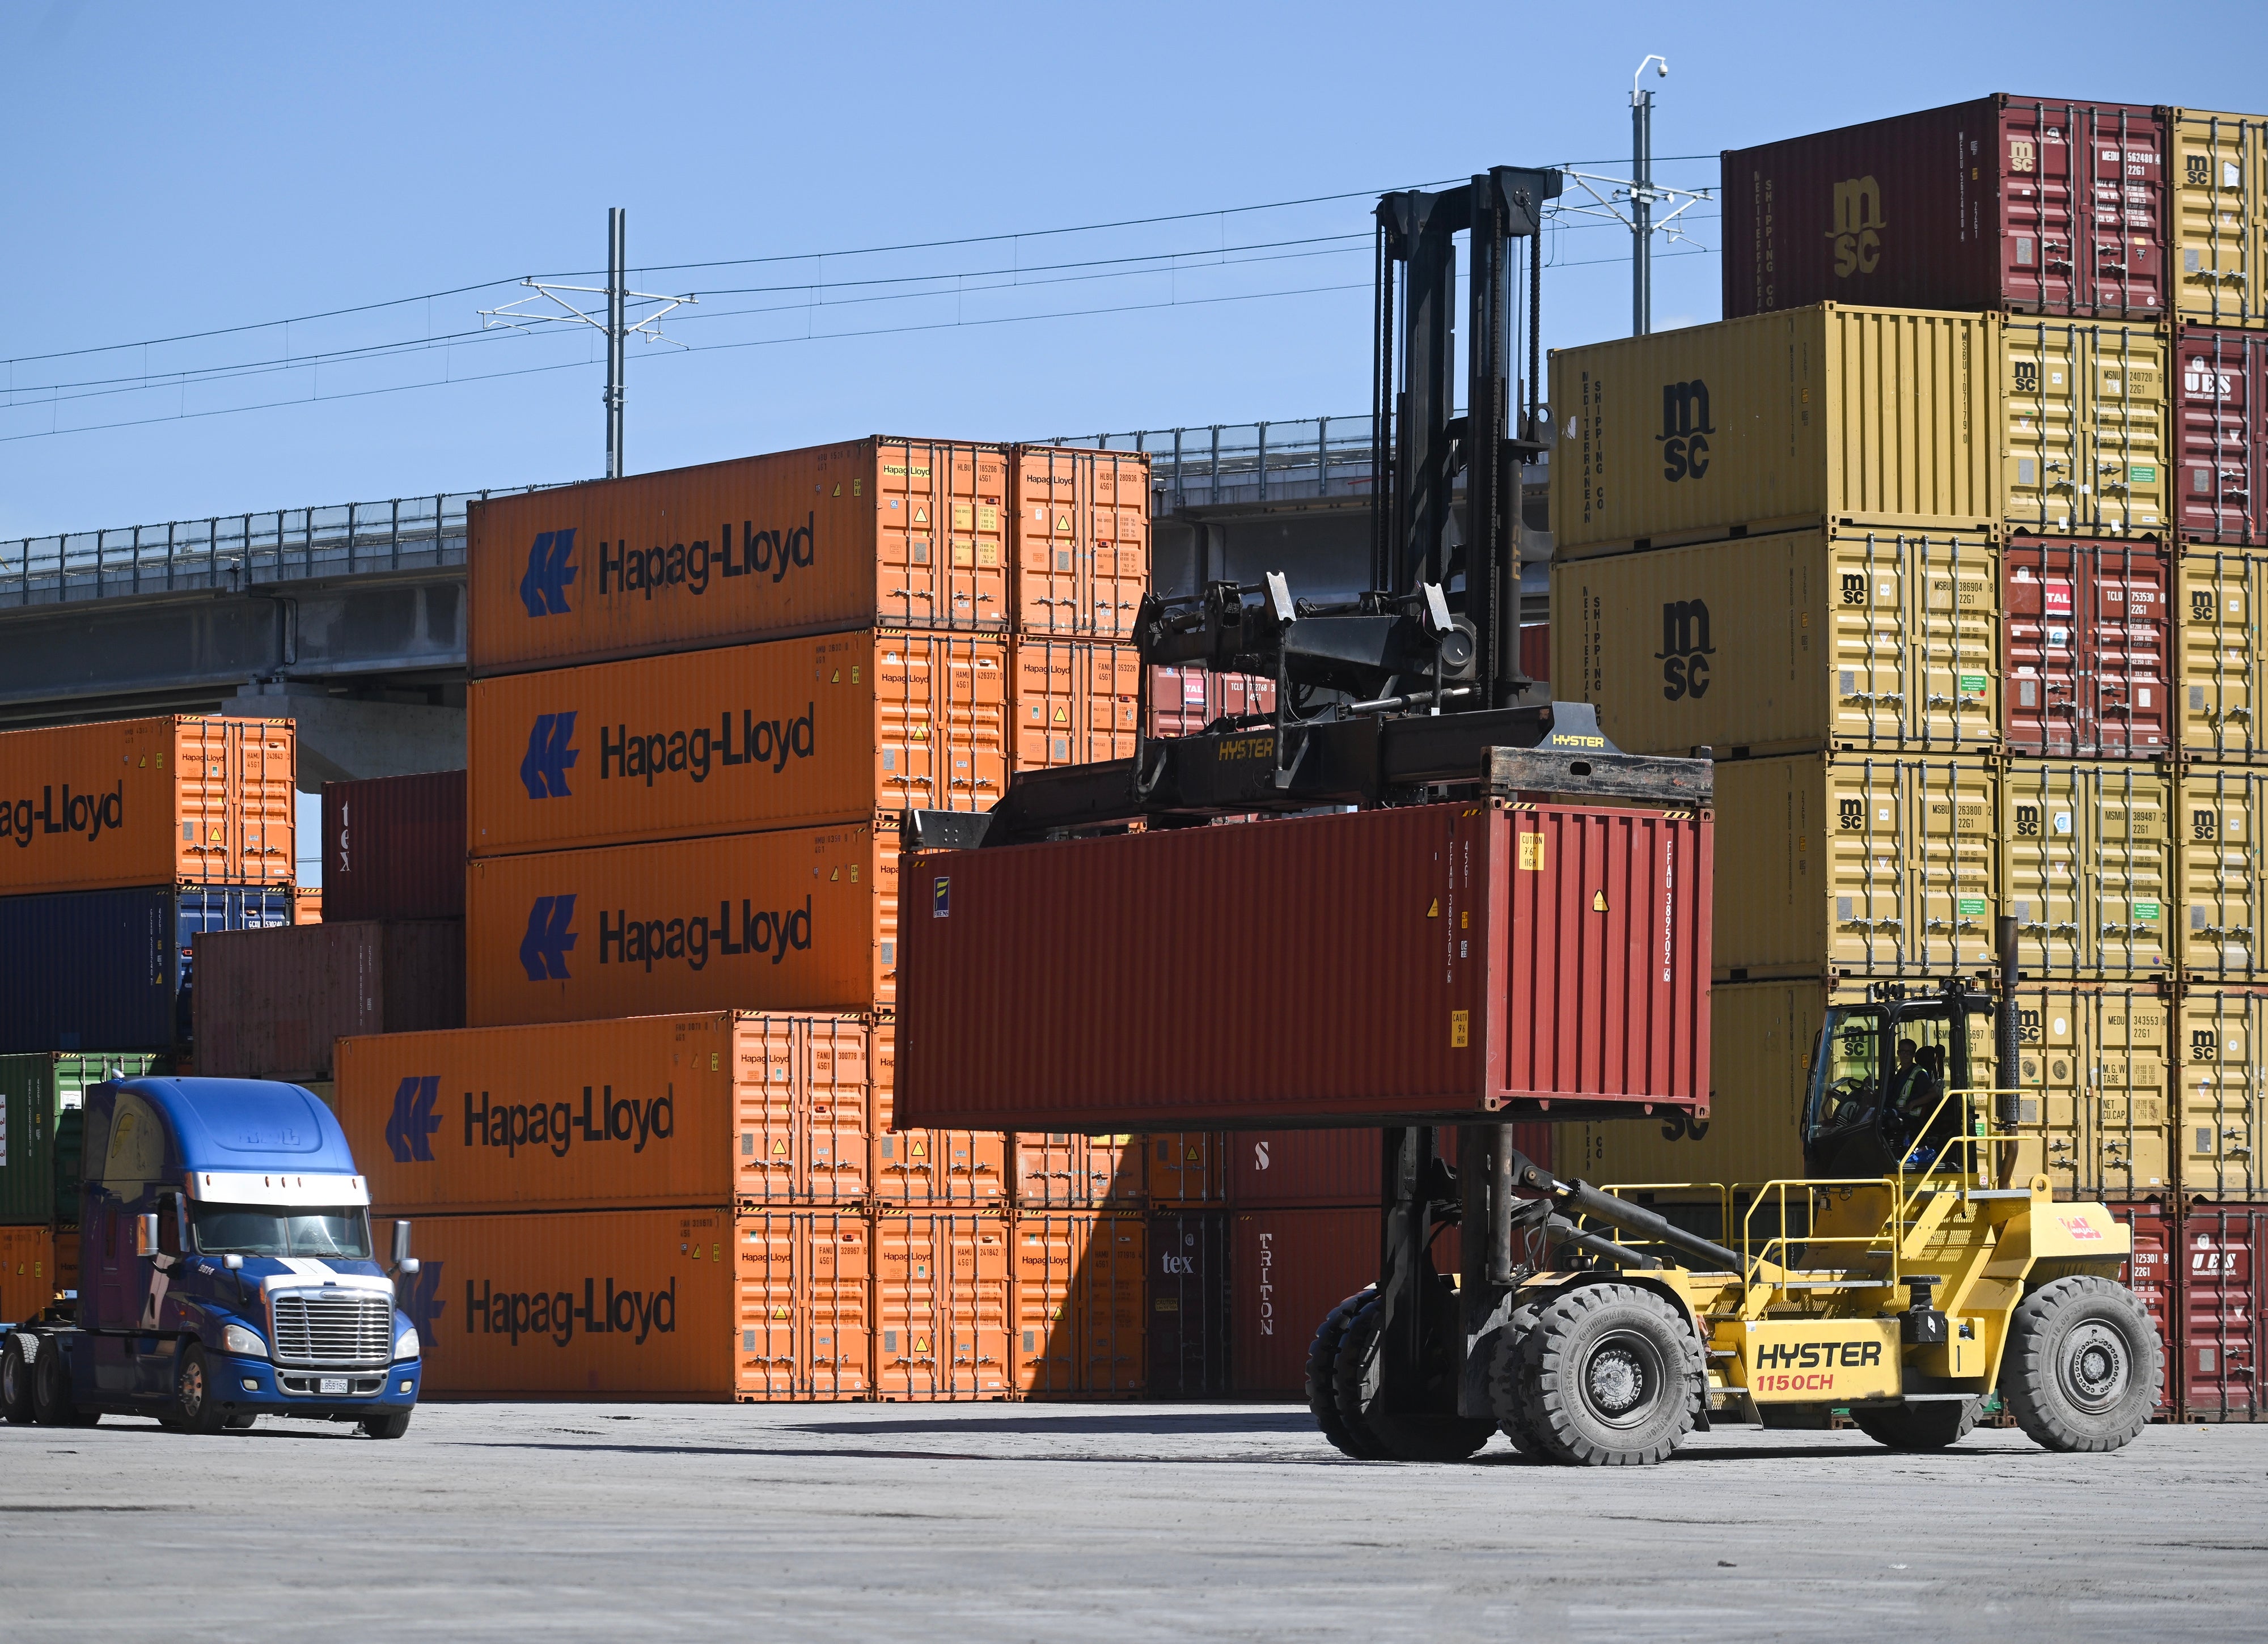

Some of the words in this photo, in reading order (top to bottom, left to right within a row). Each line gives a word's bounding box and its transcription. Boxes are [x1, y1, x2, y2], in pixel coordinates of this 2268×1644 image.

[2102, 151, 2119, 161] MEDU
[2127, 152, 2153, 163] 562480
[2128, 166, 2144, 175] 22G1
[1766, 285, 1773, 307] CO
[2104, 370, 2121, 380] MSNU
[2129, 372, 2152, 382] 240720
[2159, 374, 2163, 383] 6
[2130, 384, 2145, 394] 22G1
[1594, 381, 1603, 474] SHIPPING
[1962, 434, 1968, 444] 0
[884, 465, 930, 477] HapagLloyd
[1027, 474, 1073, 486] HapagLloyd
[1596, 488, 1603, 510] CO
[599, 511, 814, 600] Hapag-Lloyd
[1935, 581, 1951, 591] MSBU
[1959, 582, 1982, 592] 386904
[1990, 583, 1993, 592] 8
[1959, 595, 1974, 603] 22G1
[2046, 593, 2070, 603] TAL
[2106, 591, 2122, 601] TCLU
[2131, 592, 2154, 603] 753530
[2160, 593, 2165, 603] 0
[2131, 605, 2146, 615] 22G1
[1024, 664, 1070, 675] HapagLloyd
[882, 673, 928, 684] HapagLloyd
[1249, 684, 1267, 692] 72768
[1596, 704, 1601, 727] CO
[600, 702, 814, 787] Hapag-Lloyd
[1552, 734, 1604, 748] HYSTER
[1218, 738, 1275, 761] HYSTER
[183, 754, 224, 763] HapagLloyd
[1933, 805, 1949, 814] MSBU
[1958, 806, 1981, 815] 263800
[1988, 807, 1991, 816] 2
[2105, 811, 2124, 820] MSMU
[2133, 812, 2156, 821] 389487
[1958, 819, 1974, 828] 22G1
[2133, 825, 2148, 833] 22G1
[1522, 835, 1542, 845] CUTION
[599, 894, 811, 973] Hapag-Lloyd
[1664, 969, 1670, 981] 6
[2108, 1016, 2125, 1025] MEDU
[2134, 1016, 2159, 1026] 343553
[2134, 1029, 2150, 1038] 22G1
[741, 1054, 789, 1064] HapagLloyd
[2103, 1075, 2118, 1084] TARE
[2103, 1100, 2114, 1109] NET
[464, 1082, 673, 1158] Hapag-Lloyd
[1596, 1136, 1602, 1159] CO
[1255, 1142, 1270, 1170] S
[742, 1253, 790, 1262] HapagLloyd
[884, 1252, 931, 1261] HapagLloyd
[1022, 1256, 1069, 1266] HapagLloyd
[2135, 1253, 2158, 1264] 125301
[2164, 1253, 2168, 1264] 9
[1162, 1251, 1194, 1274] tex
[198, 1265, 215, 1275] 9814
[2135, 1266, 2150, 1277] 22G1
[1260, 1234, 1273, 1335] TRITON
[466, 1276, 675, 1346] Hapag-Lloyd
[1756, 1341, 1881, 1369] HYSTER
[1757, 1374, 1834, 1391] 1150CH
